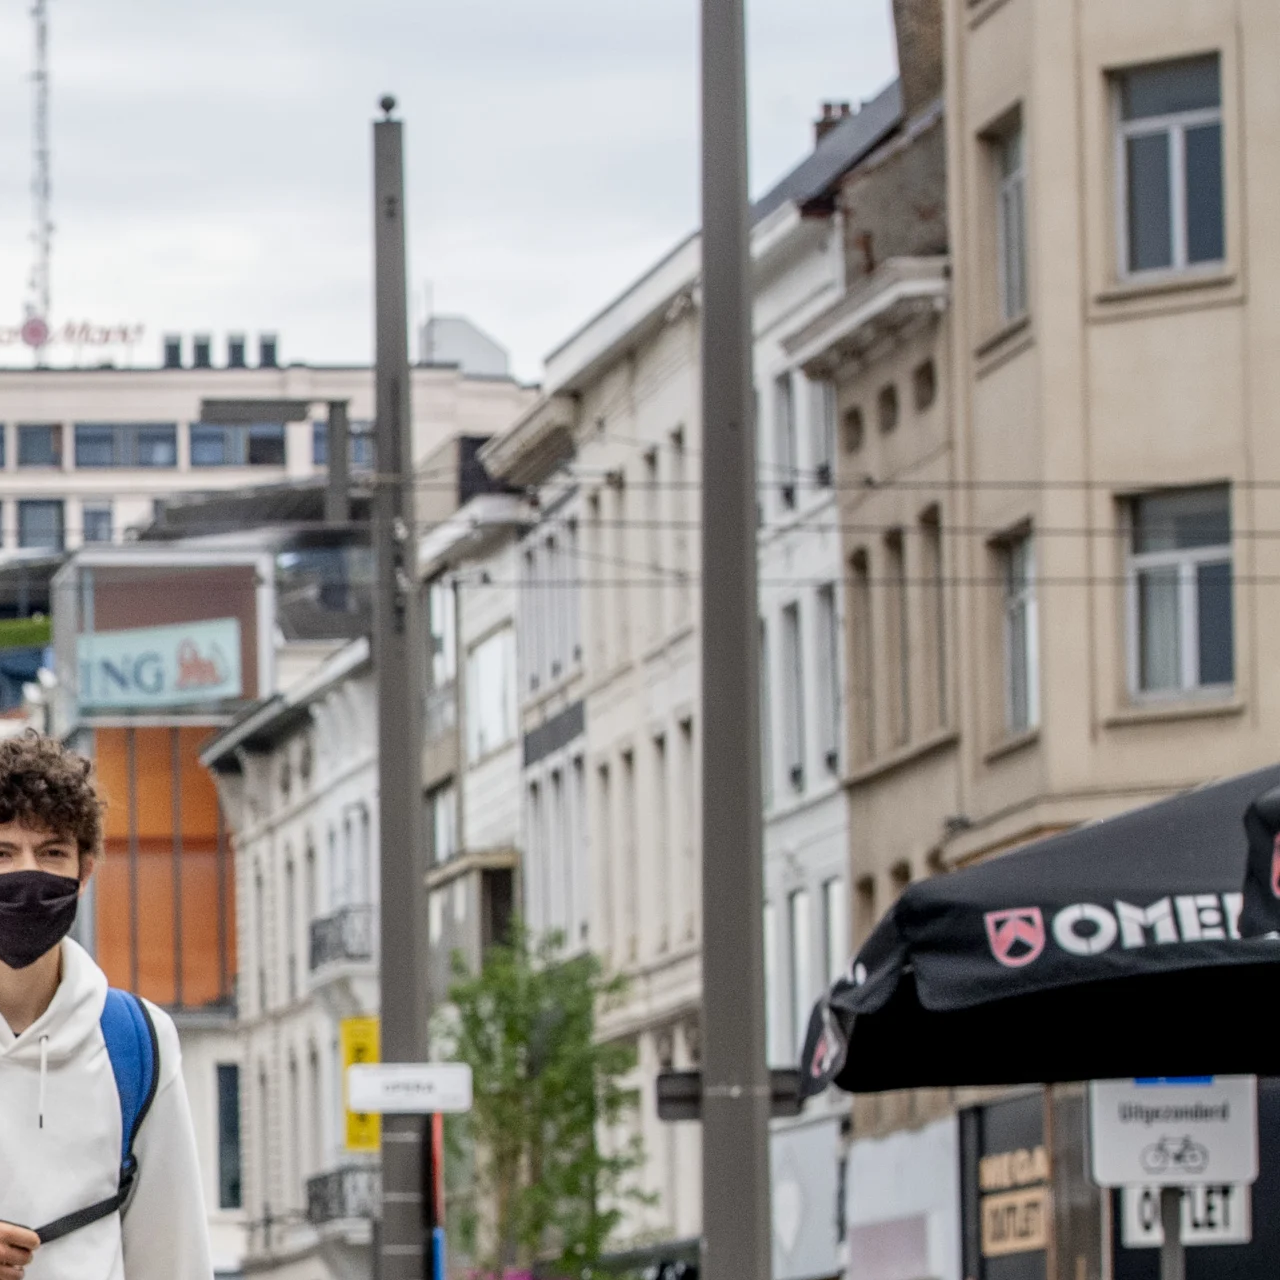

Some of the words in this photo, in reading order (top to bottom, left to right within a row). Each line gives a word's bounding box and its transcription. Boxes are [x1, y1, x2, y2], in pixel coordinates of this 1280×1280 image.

[78, 651, 165, 697] ING
[1118, 1101, 1230, 1126] Uitgezonderd
[980, 1145, 1048, 1189] MEGA
